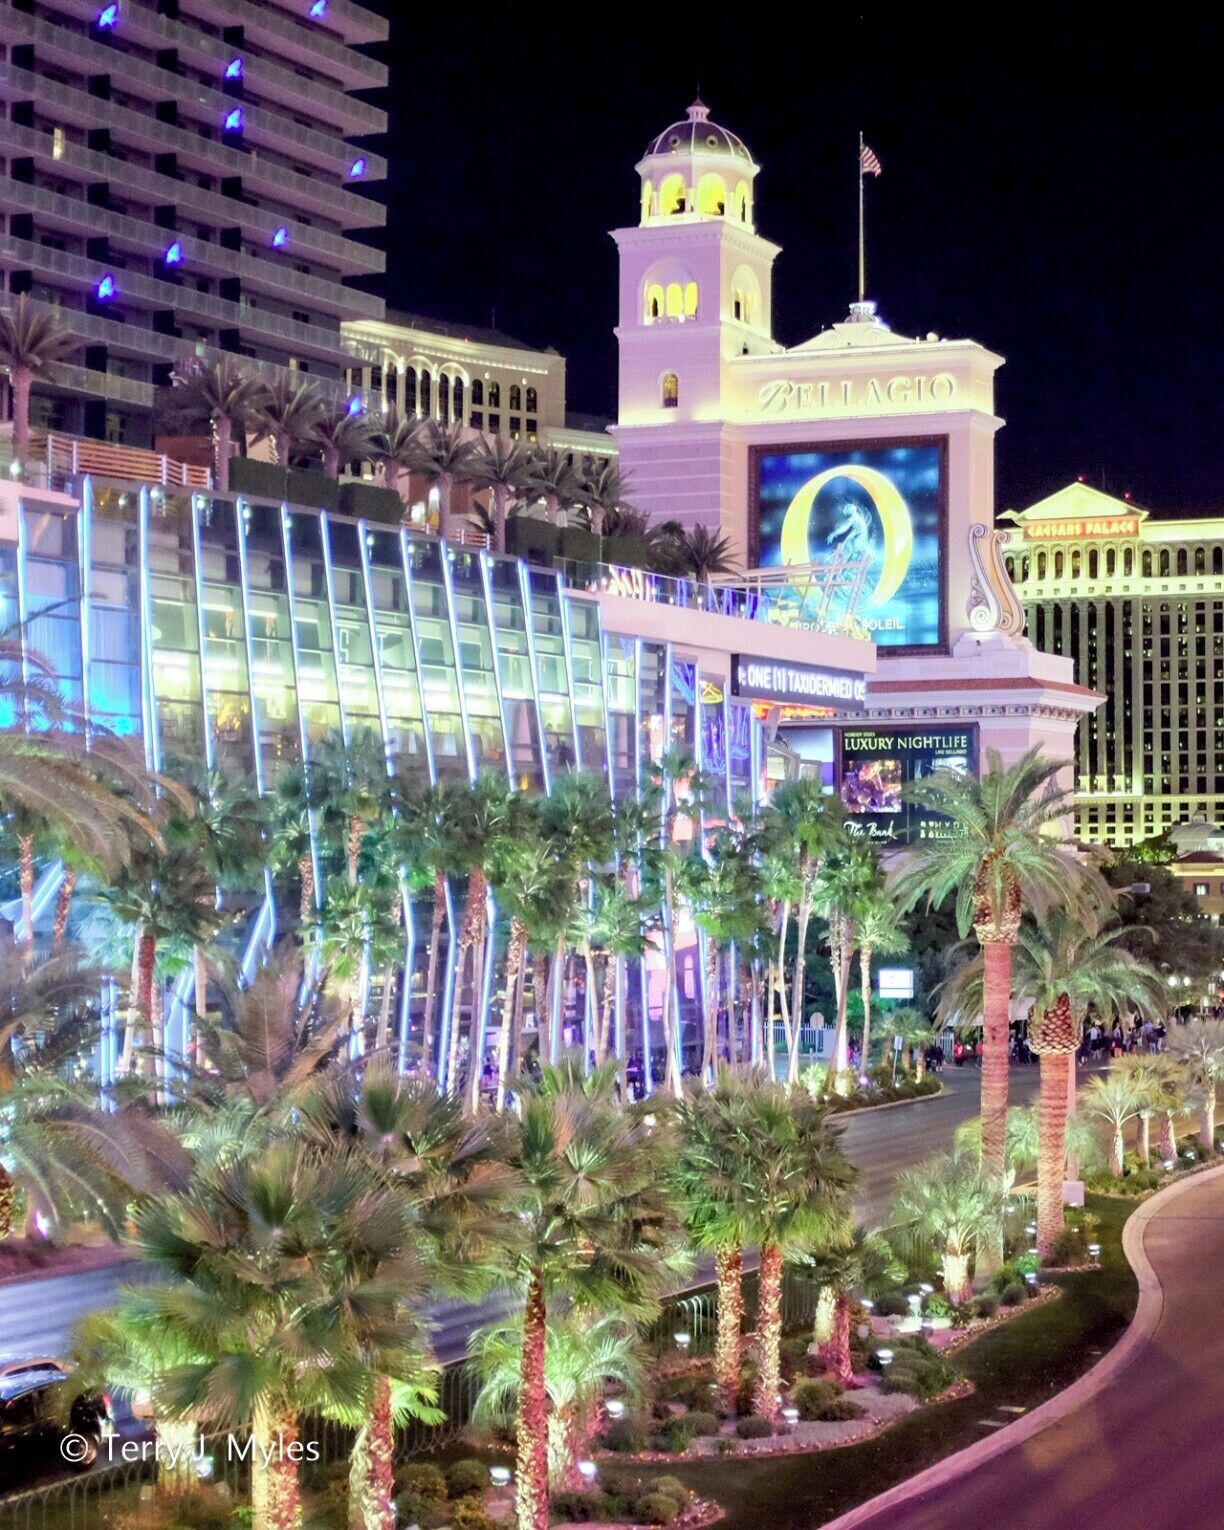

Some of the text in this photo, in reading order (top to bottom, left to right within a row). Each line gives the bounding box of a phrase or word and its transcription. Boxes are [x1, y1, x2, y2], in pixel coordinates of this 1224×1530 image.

[1085, 520, 1136, 535] PALACE
[748, 664, 771, 689] ONE
[788, 671, 853, 700] TAXIDERMIED
[844, 735, 967, 751] LUXURY NIGHTLIFE
[843, 820, 898, 840] The Bank
